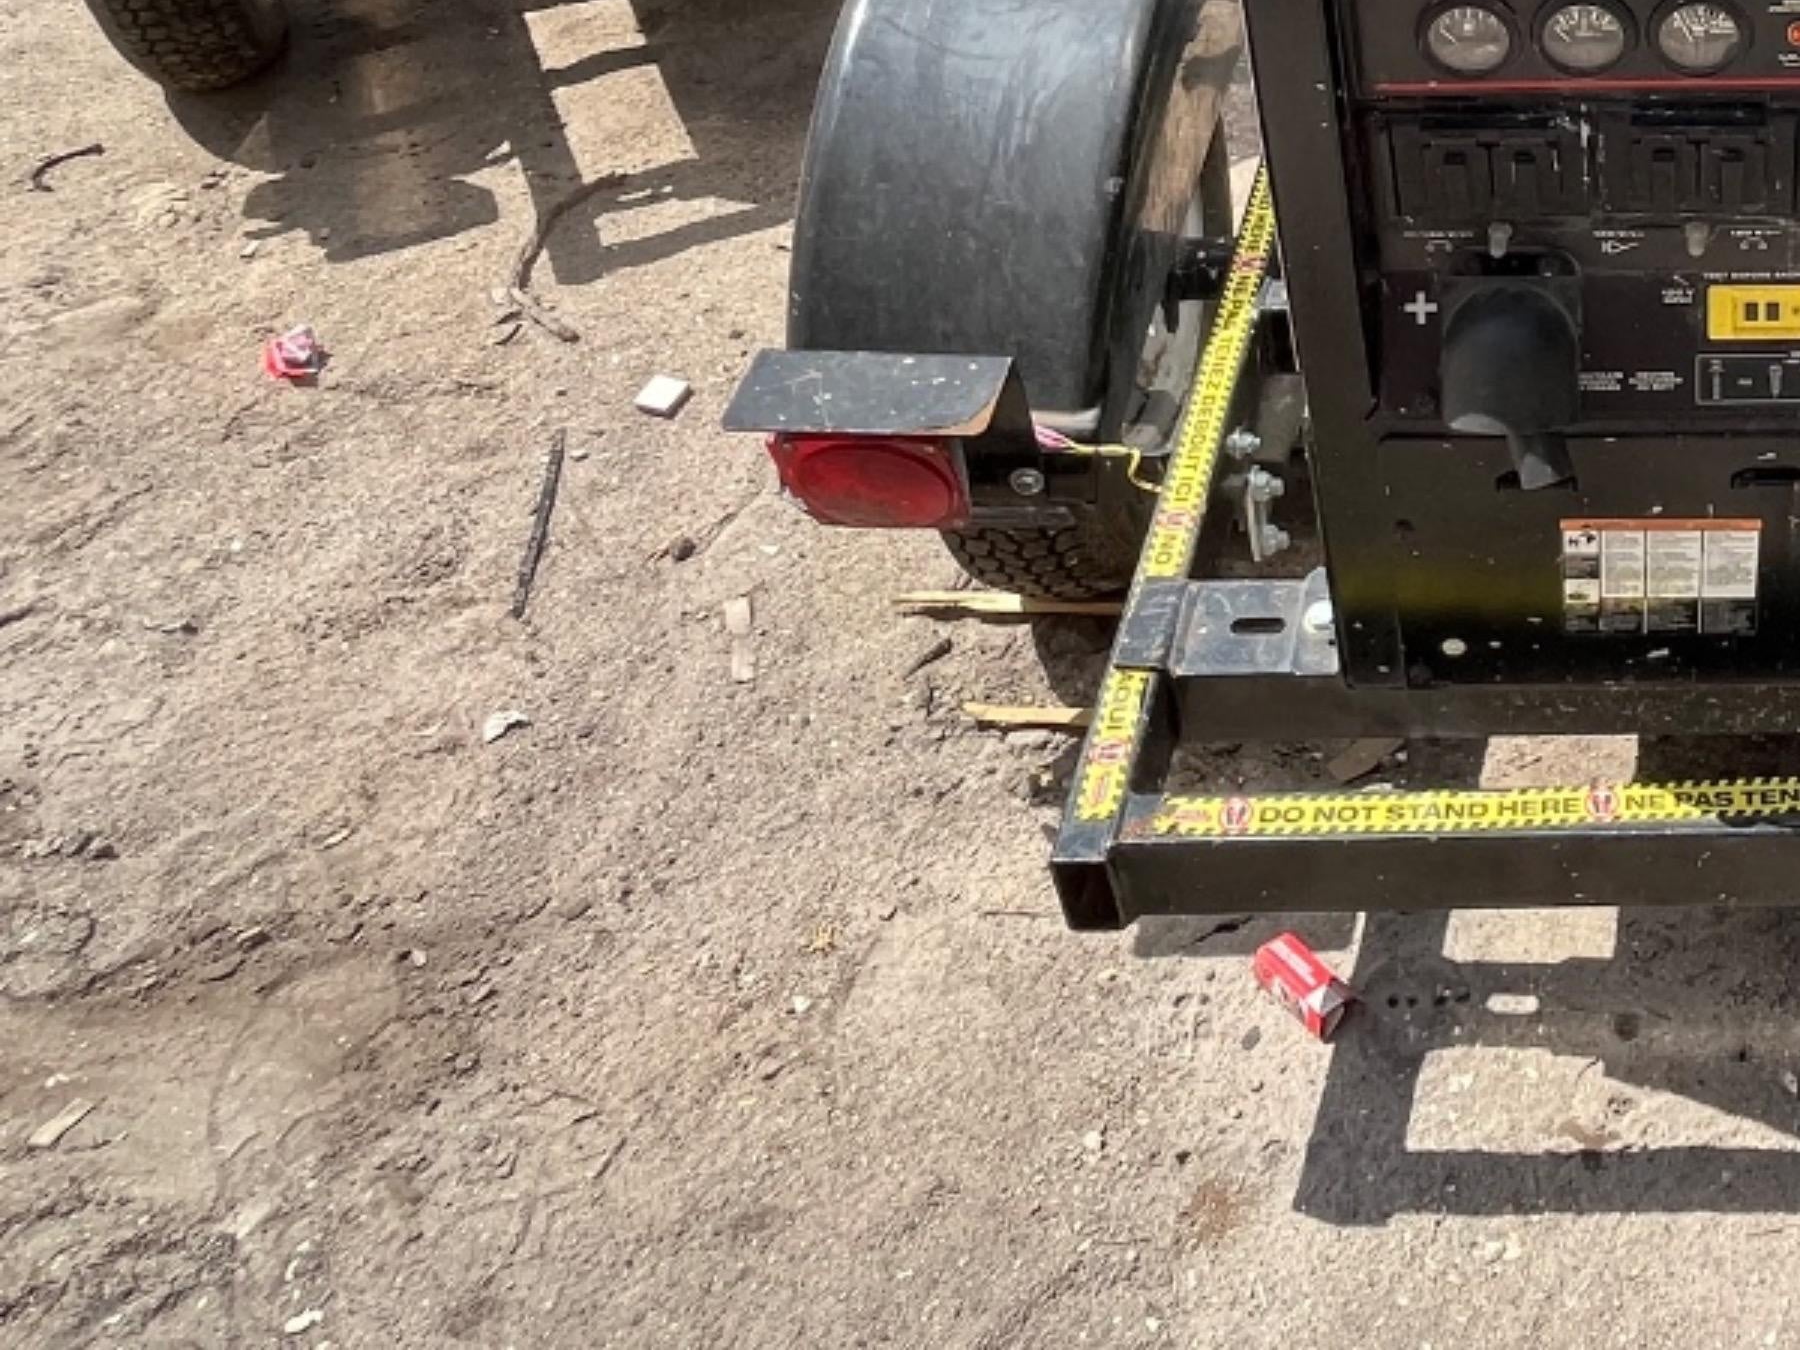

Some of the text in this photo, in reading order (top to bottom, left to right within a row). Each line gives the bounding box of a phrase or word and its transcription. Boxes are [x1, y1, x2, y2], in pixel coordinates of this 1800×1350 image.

[1259, 807, 1307, 825] DO
[1313, 805, 1379, 822] NOT
[1385, 800, 1488, 821] STAND
[1497, 797, 1579, 817] HERE
[1624, 794, 1666, 811] NE
[1675, 790, 1735, 808] PAS
